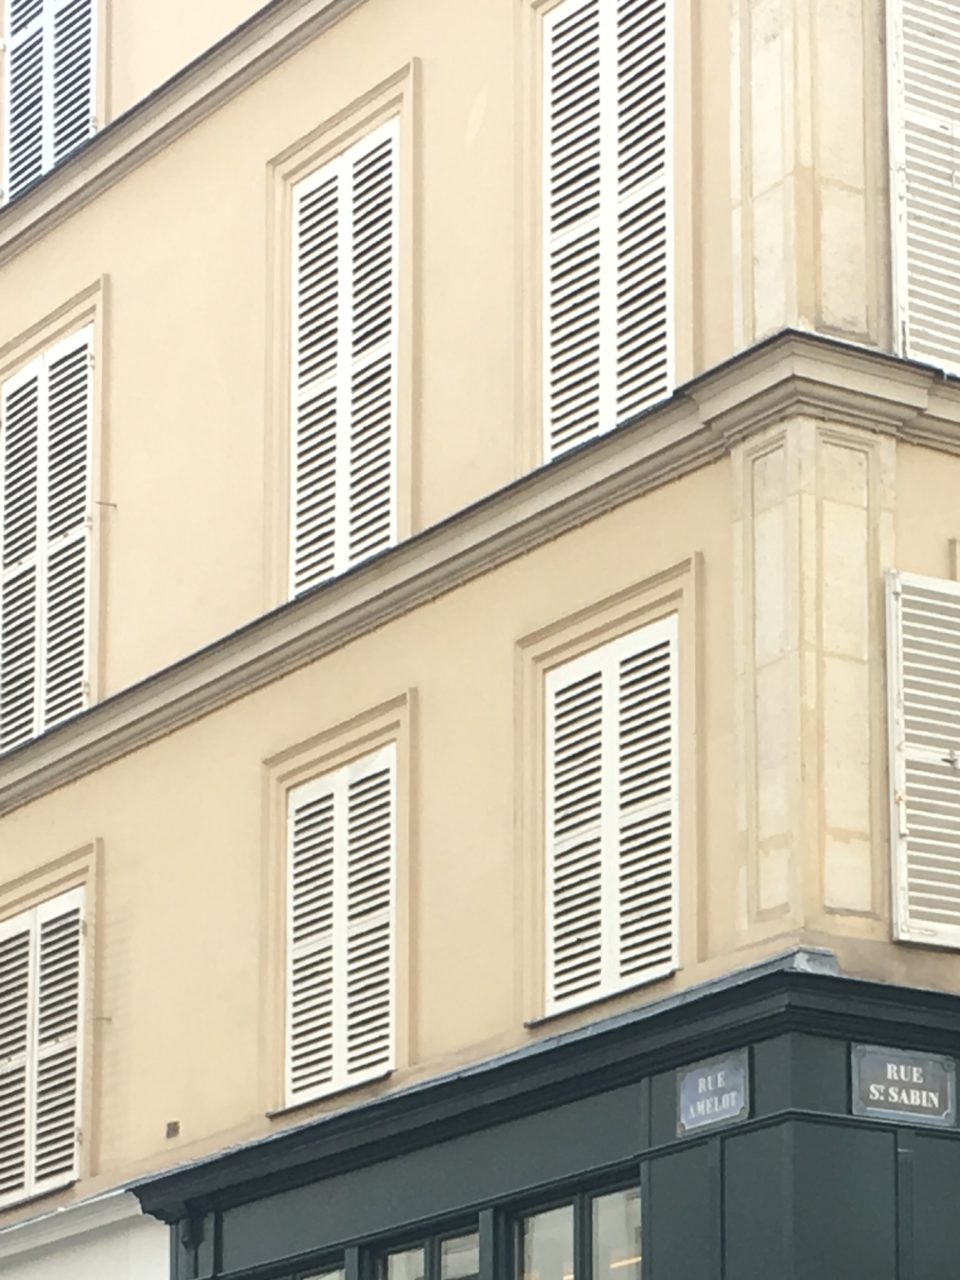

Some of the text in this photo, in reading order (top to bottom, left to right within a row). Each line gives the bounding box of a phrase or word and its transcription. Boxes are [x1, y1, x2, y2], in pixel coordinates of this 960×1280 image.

[698, 1071, 726, 1094] RUE
[886, 1063, 923, 1084] RUE
[688, 1091, 737, 1118] AMELOT
[888, 1086, 939, 1108] SABIN
